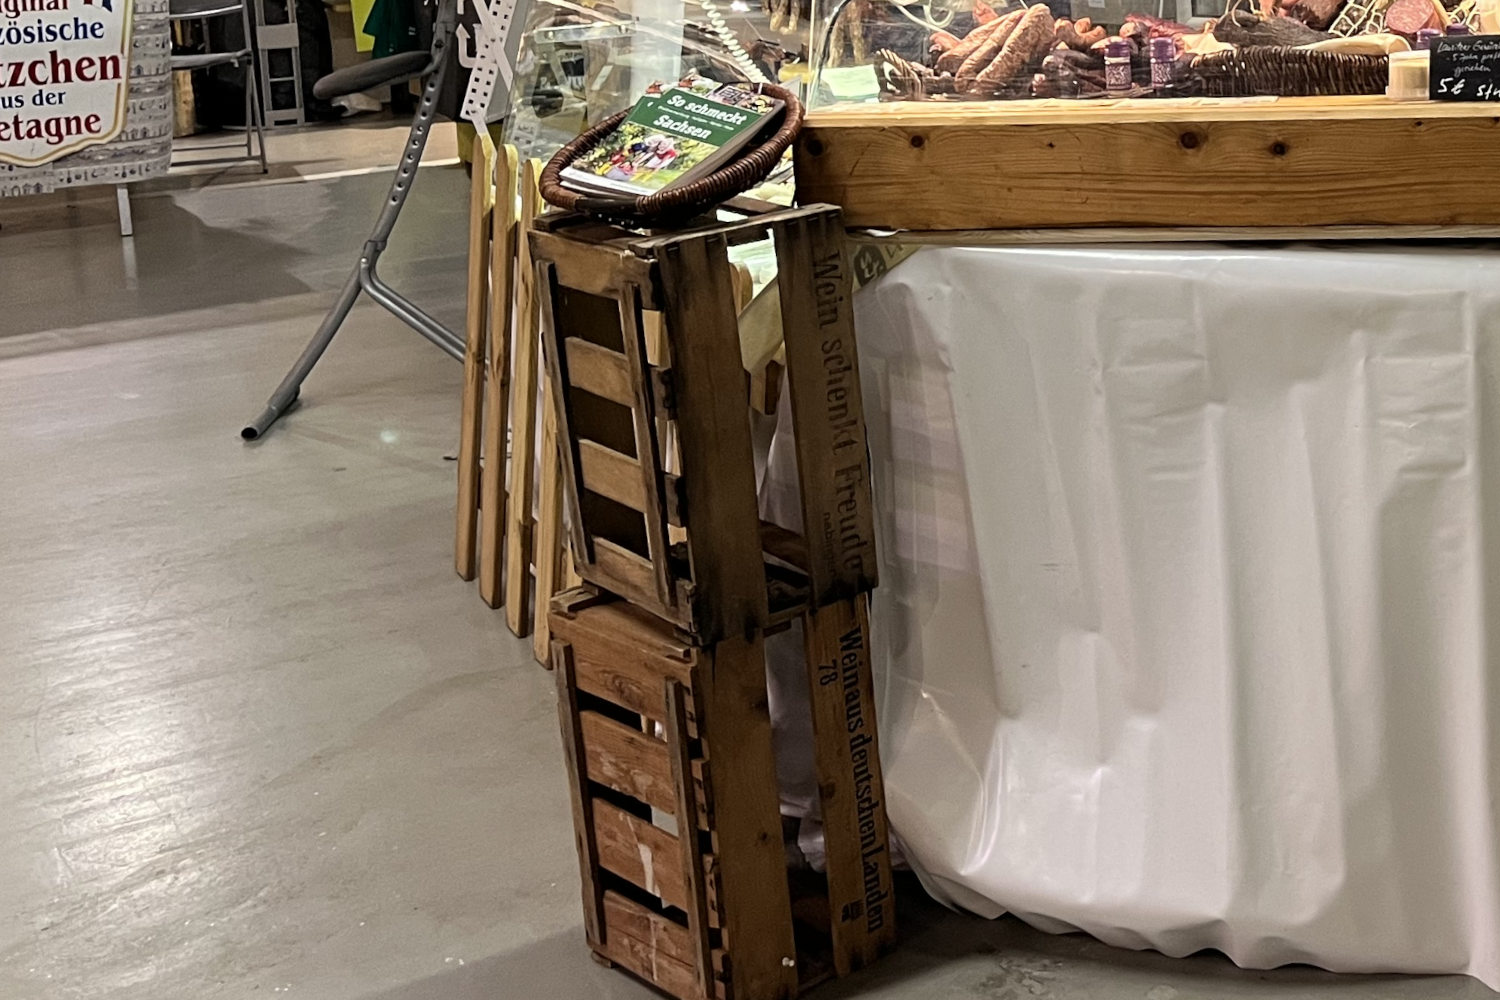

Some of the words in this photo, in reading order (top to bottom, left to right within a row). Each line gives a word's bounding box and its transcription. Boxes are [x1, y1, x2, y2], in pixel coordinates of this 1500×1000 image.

[1, 93, 24, 109] us
[32, 89, 66, 106] der
[653, 114, 712, 139] Sachsen
[666, 95, 686, 107] So
[684, 103, 748, 125] schmeckt
[0, 113, 102, 145] etagne
[814, 250, 844, 329] Wein
[821, 339, 858, 455] schenkt
[835, 464, 868, 577] Freude
[818, 658, 838, 686] 78
[839, 624, 863, 690] Wein
[845, 689, 865, 734] aus
[850, 733, 879, 849] deutschen
[862, 843, 889, 934] Landen
